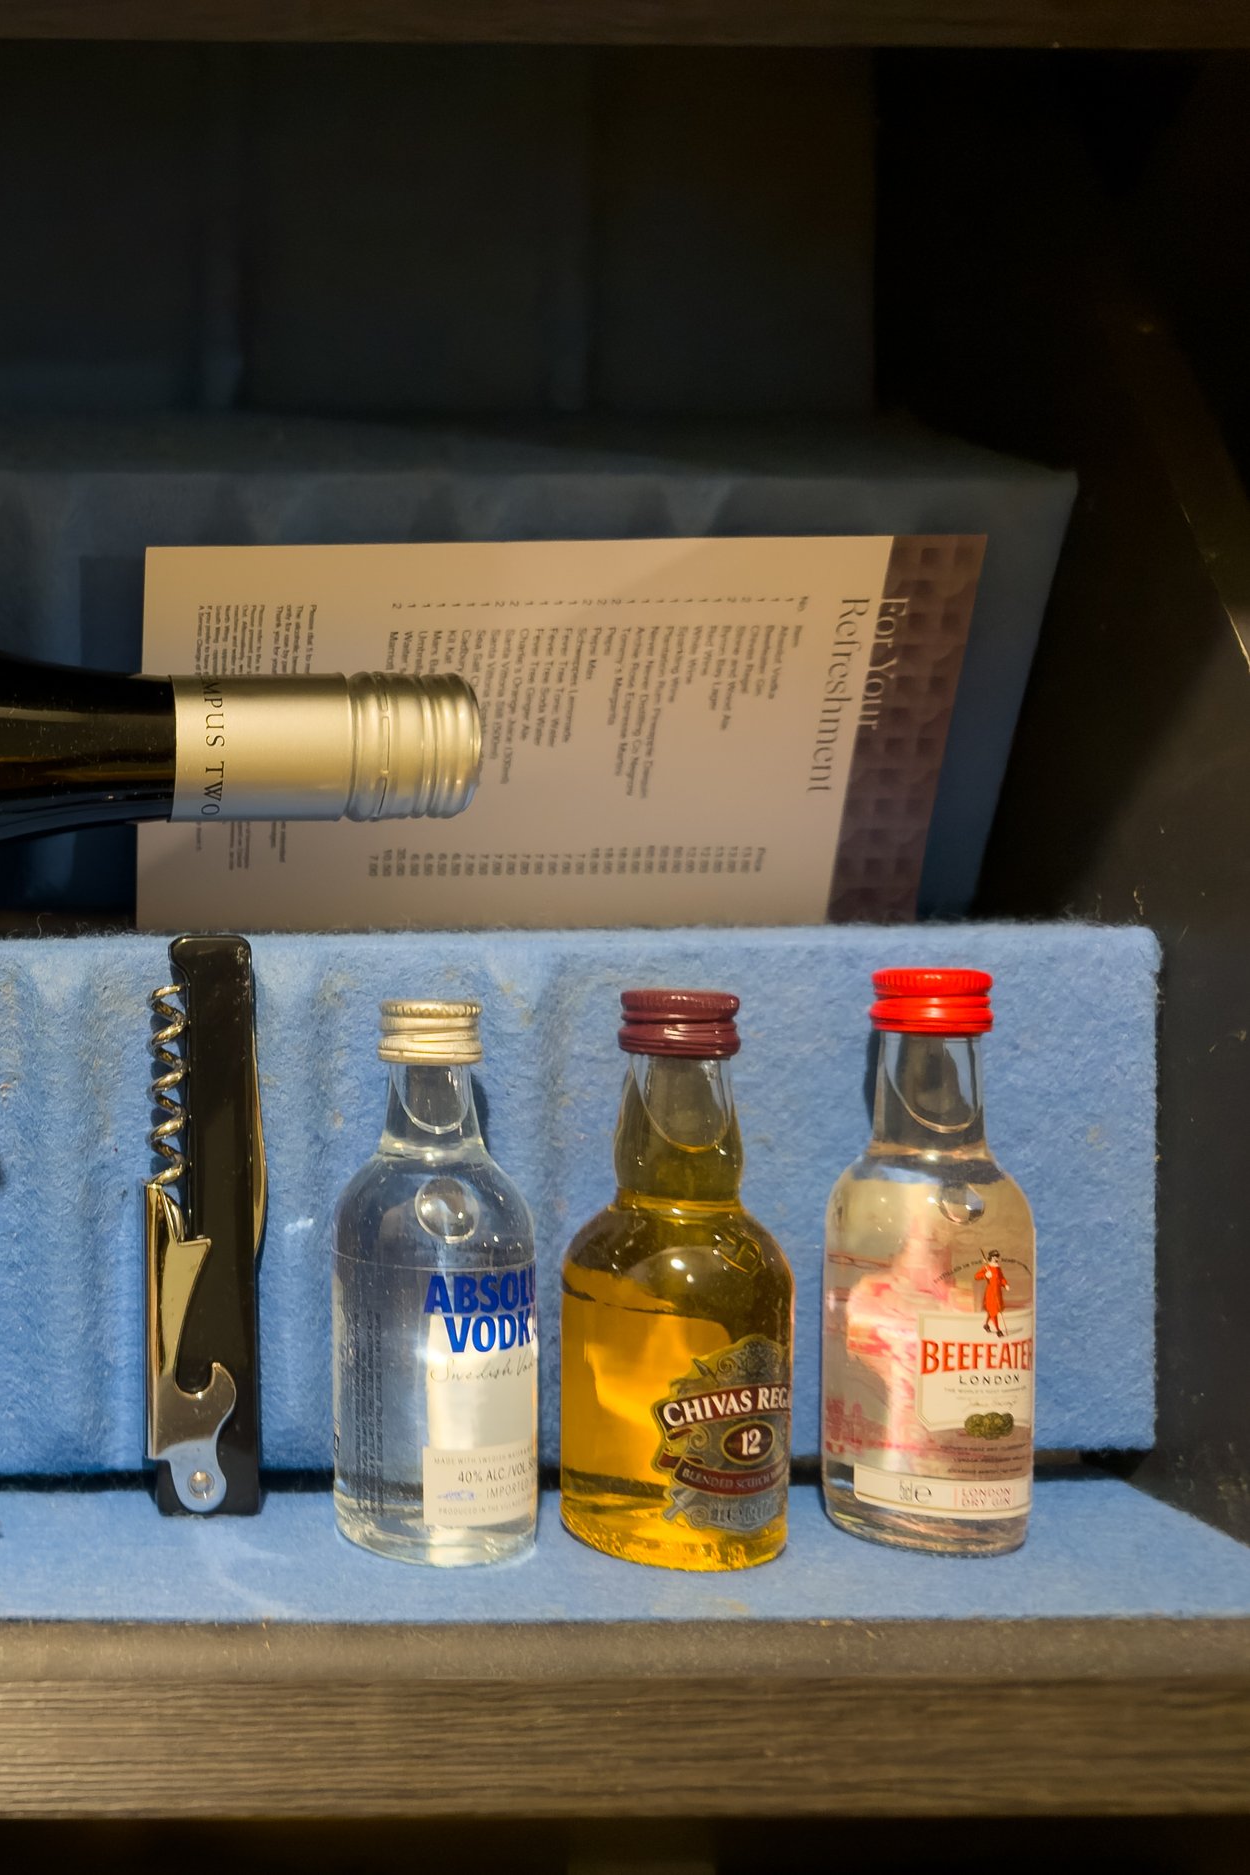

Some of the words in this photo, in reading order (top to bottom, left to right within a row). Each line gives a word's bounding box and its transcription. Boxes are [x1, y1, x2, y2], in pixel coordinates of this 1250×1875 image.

[276, 606, 284, 628] Thank
[284, 604, 292, 620] only
[296, 605, 304, 619] The
[308, 604, 318, 630] Please
[874, 597, 913, 648] For
[272, 631, 280, 646] you
[284, 622, 292, 632] for
[293, 622, 301, 653] alcoholic
[474, 630, 486, 650] Sea
[588, 626, 602, 656] Pepsi
[603, 626, 617, 656] Pepsi
[647, 626, 660, 656] Never
[690, 626, 703, 656] White
[706, 626, 718, 647] Red
[282, 650, 290, 660] by
[430, 630, 443, 656] Mars
[444, 646, 455, 664] Kat
[455, 630, 472, 673] Cadbury
[487, 629, 501, 660] Santa
[502, 629, 516, 660] Santa
[531, 628, 544, 656] Fever
[546, 628, 558, 656] Fever
[560, 628, 573, 656] Fever
[631, 626, 646, 658] Archie
[671, 626, 689, 674] Sparkling
[471, 653, 483, 673] Salt
[569, 628, 588, 686] Schweppes
[586, 659, 598, 680] Max
[686, 658, 697, 684] Wine
[700, 650, 712, 676] Wine
[714, 659, 726, 678] Bay
[729, 659, 738, 678] and
[527, 660, 540, 684] Tree
[542, 660, 554, 684] Tree
[557, 660, 568, 684] Tree
[768, 667, 782, 700] Vodka
[507, 677, 523, 716] Orange
[522, 688, 536, 720] Ginger
[538, 688, 550, 714] Soda
[551, 688, 564, 716] Tonic
[606, 677, 622, 726] Margarita
[668, 677, 679, 703] Wine
[708, 682, 722, 710] Lager
[806, 598, 870, 794] Refreshment
[858, 657, 898, 730] Your
[201, 679, 225, 747] MPUS
[562, 690, 579, 743] Lemonade
[632, 694, 650, 737] Distilling
[520, 724, 530, 742] Ale
[533, 716, 546, 746] Water
[547, 718, 560, 748] Water
[201, 761, 224, 816] TWO
[368, 856, 378, 877] 7.00
[382, 848, 392, 878] 10.50
[423, 1263, 536, 1314] ABSOLU
[444, 1307, 537, 1353] VODK
[430, 1358, 513, 1383] Swedish
[959, 1374, 1020, 1386] LONDON
[662, 1390, 752, 1427] CHIVAS
[757, 1386, 790, 1410] REG
[741, 1428, 762, 1456] 12
[458, 1470, 482, 1484] 40%
[486, 1479, 529, 1499] IMPORTED
[682, 1468, 734, 1490] BLENDED
[962, 1487, 1012, 1496] LONDON
[962, 1499, 986, 1508] DRY
[991, 1498, 1012, 1506] GIN
